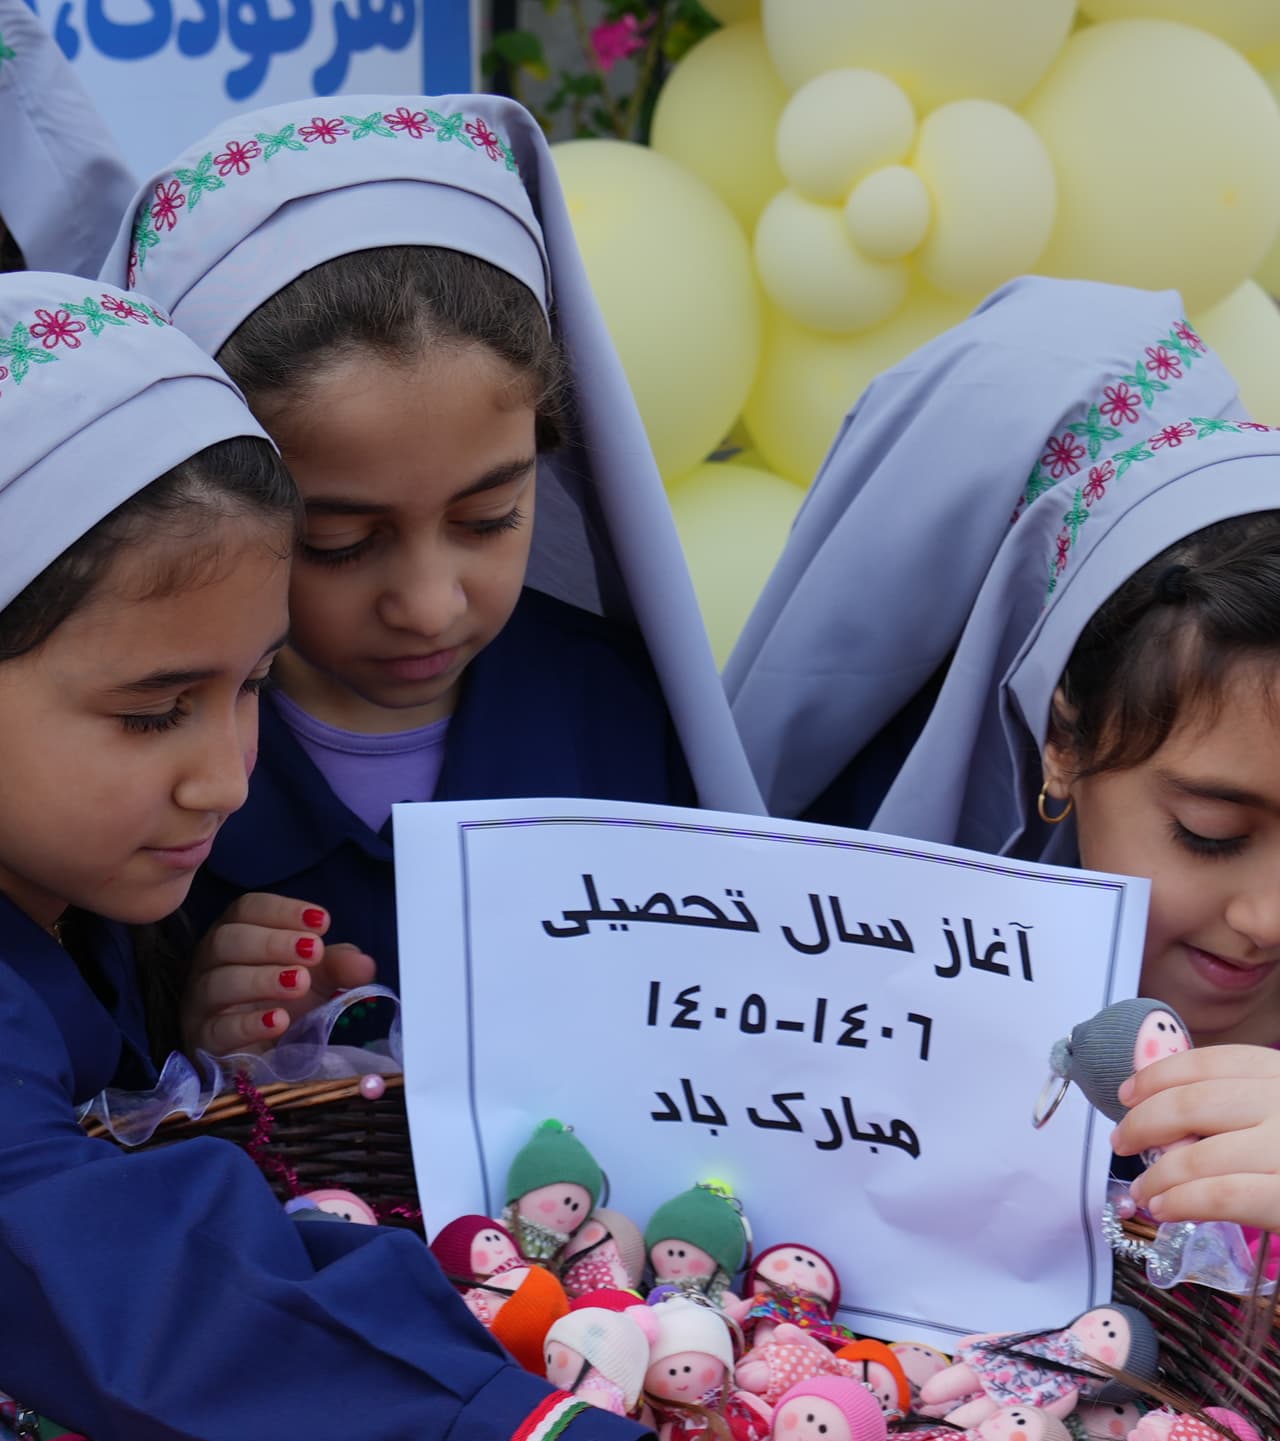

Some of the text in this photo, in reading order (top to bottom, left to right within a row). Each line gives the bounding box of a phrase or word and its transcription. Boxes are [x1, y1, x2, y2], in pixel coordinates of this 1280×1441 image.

[541, 874, 1035, 982] آغاز سال تحصیلی
[650, 1078, 921, 1159] مبارک باد
